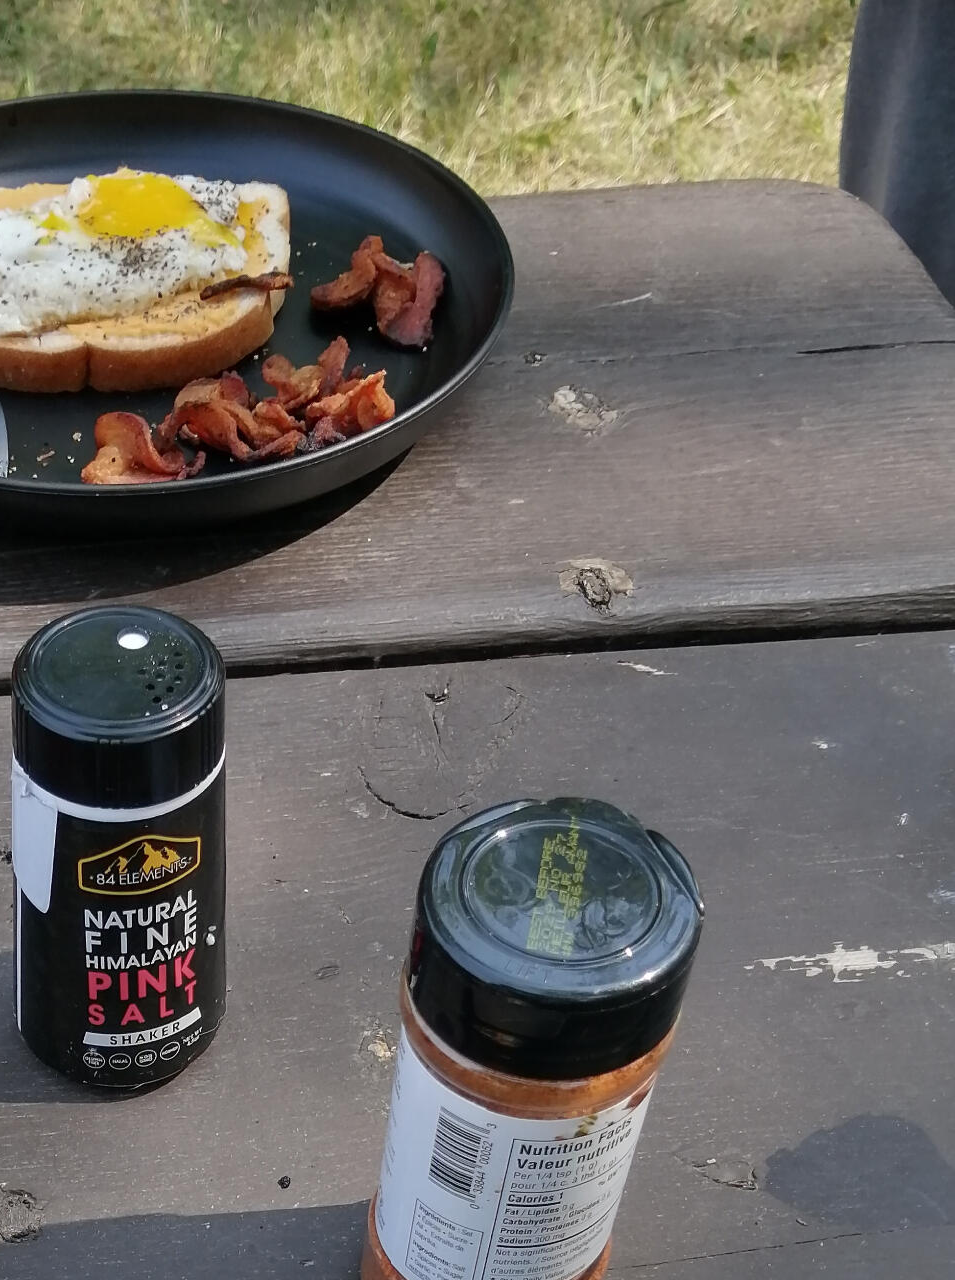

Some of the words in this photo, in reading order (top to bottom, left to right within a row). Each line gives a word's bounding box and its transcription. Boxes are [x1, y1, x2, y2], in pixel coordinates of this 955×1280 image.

[97, 873, 115, 885] 84
[120, 858, 188, 885] ELEMENTS
[85, 890, 197, 929] NATURAL
[85, 908, 197, 953] FINE
[85, 931, 197, 970] HIMALAYAN
[88, 948, 195, 1000] PINK
[88, 980, 196, 1025] SALT
[110, 1022, 180, 1045] SHAKER
[519, 1139, 592, 1155] Nutrition
[598, 1116, 632, 1143] Facts
[480, 1141, 493, 1164] 00052
[517, 1157, 572, 1170] Valeur
[577, 1127, 632, 1164] nutritive
[511, 1182, 536, 1190] pour
[513, 1171, 532, 1180] Per
[537, 1171, 552, 1180] 1/4
[556, 1169, 571, 1180] tsp
[508, 1194, 554, 1203] Calories
[503, 1216, 560, 1226] Carbohydrate
[528, 1207, 559, 1216] Lipides
[500, 1227, 532, 1235] Protein
